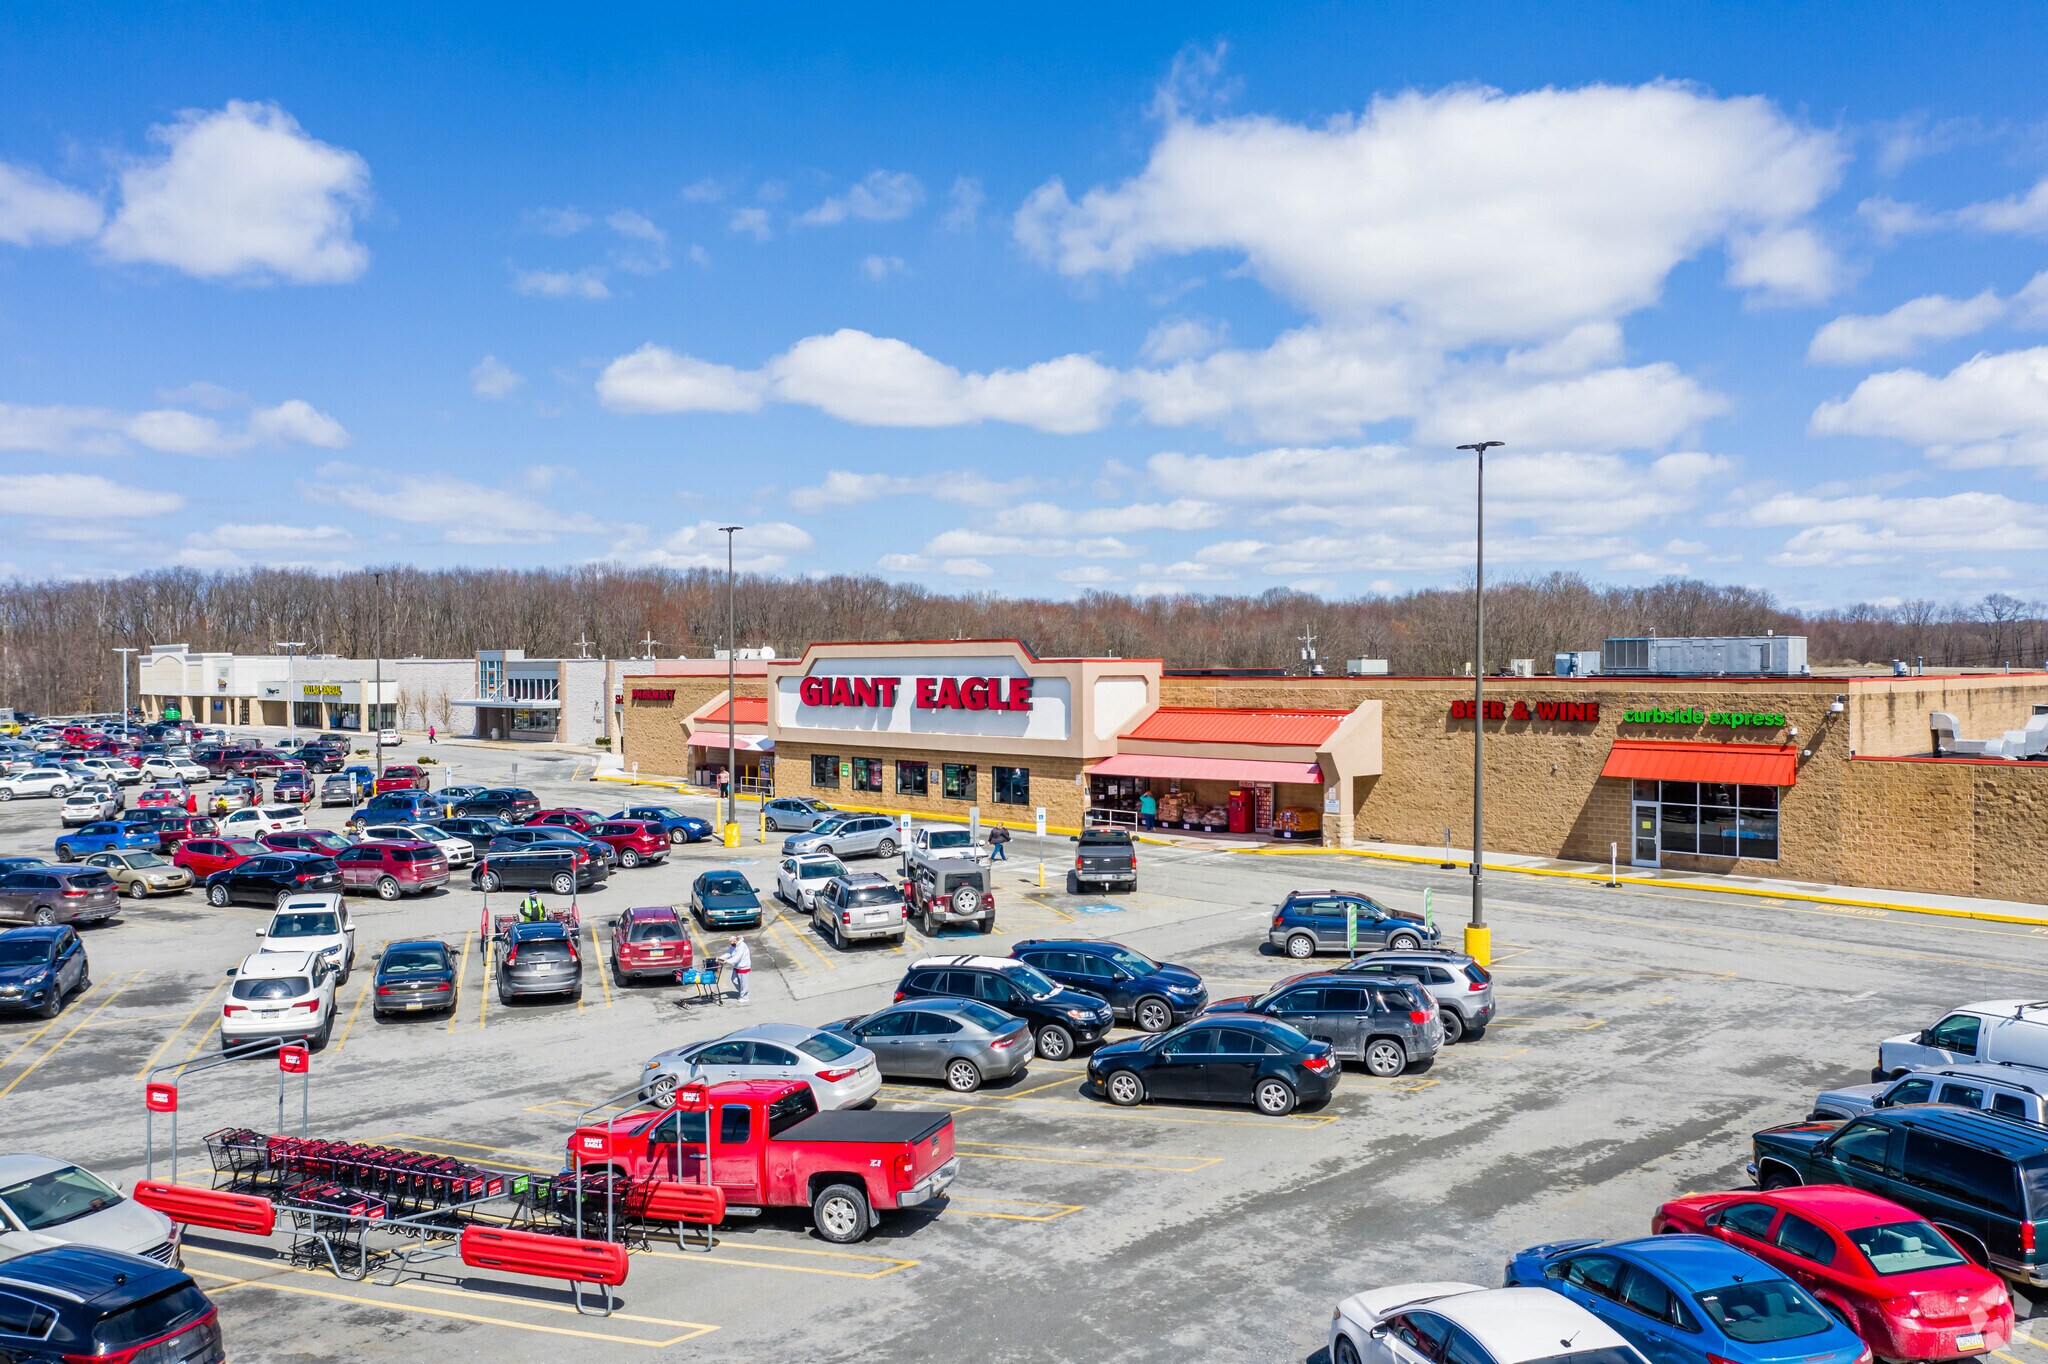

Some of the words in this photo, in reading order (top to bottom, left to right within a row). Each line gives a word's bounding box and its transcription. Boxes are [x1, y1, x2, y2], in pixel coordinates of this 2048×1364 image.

[303, 685, 321, 695] DOLLAR
[322, 685, 342, 695] GENERAL
[632, 689, 676, 701] PHARMACY
[799, 677, 900, 707] GIANT
[916, 677, 1034, 711] EAGLE
[1451, 700, 1507, 719] BEER
[1511, 700, 1532, 720] &
[1536, 702, 1600, 722] WINE
[1623, 708, 1705, 724] curbside
[1709, 713, 1786, 728] express
[1815, 905, 1889, 917] PARKING
